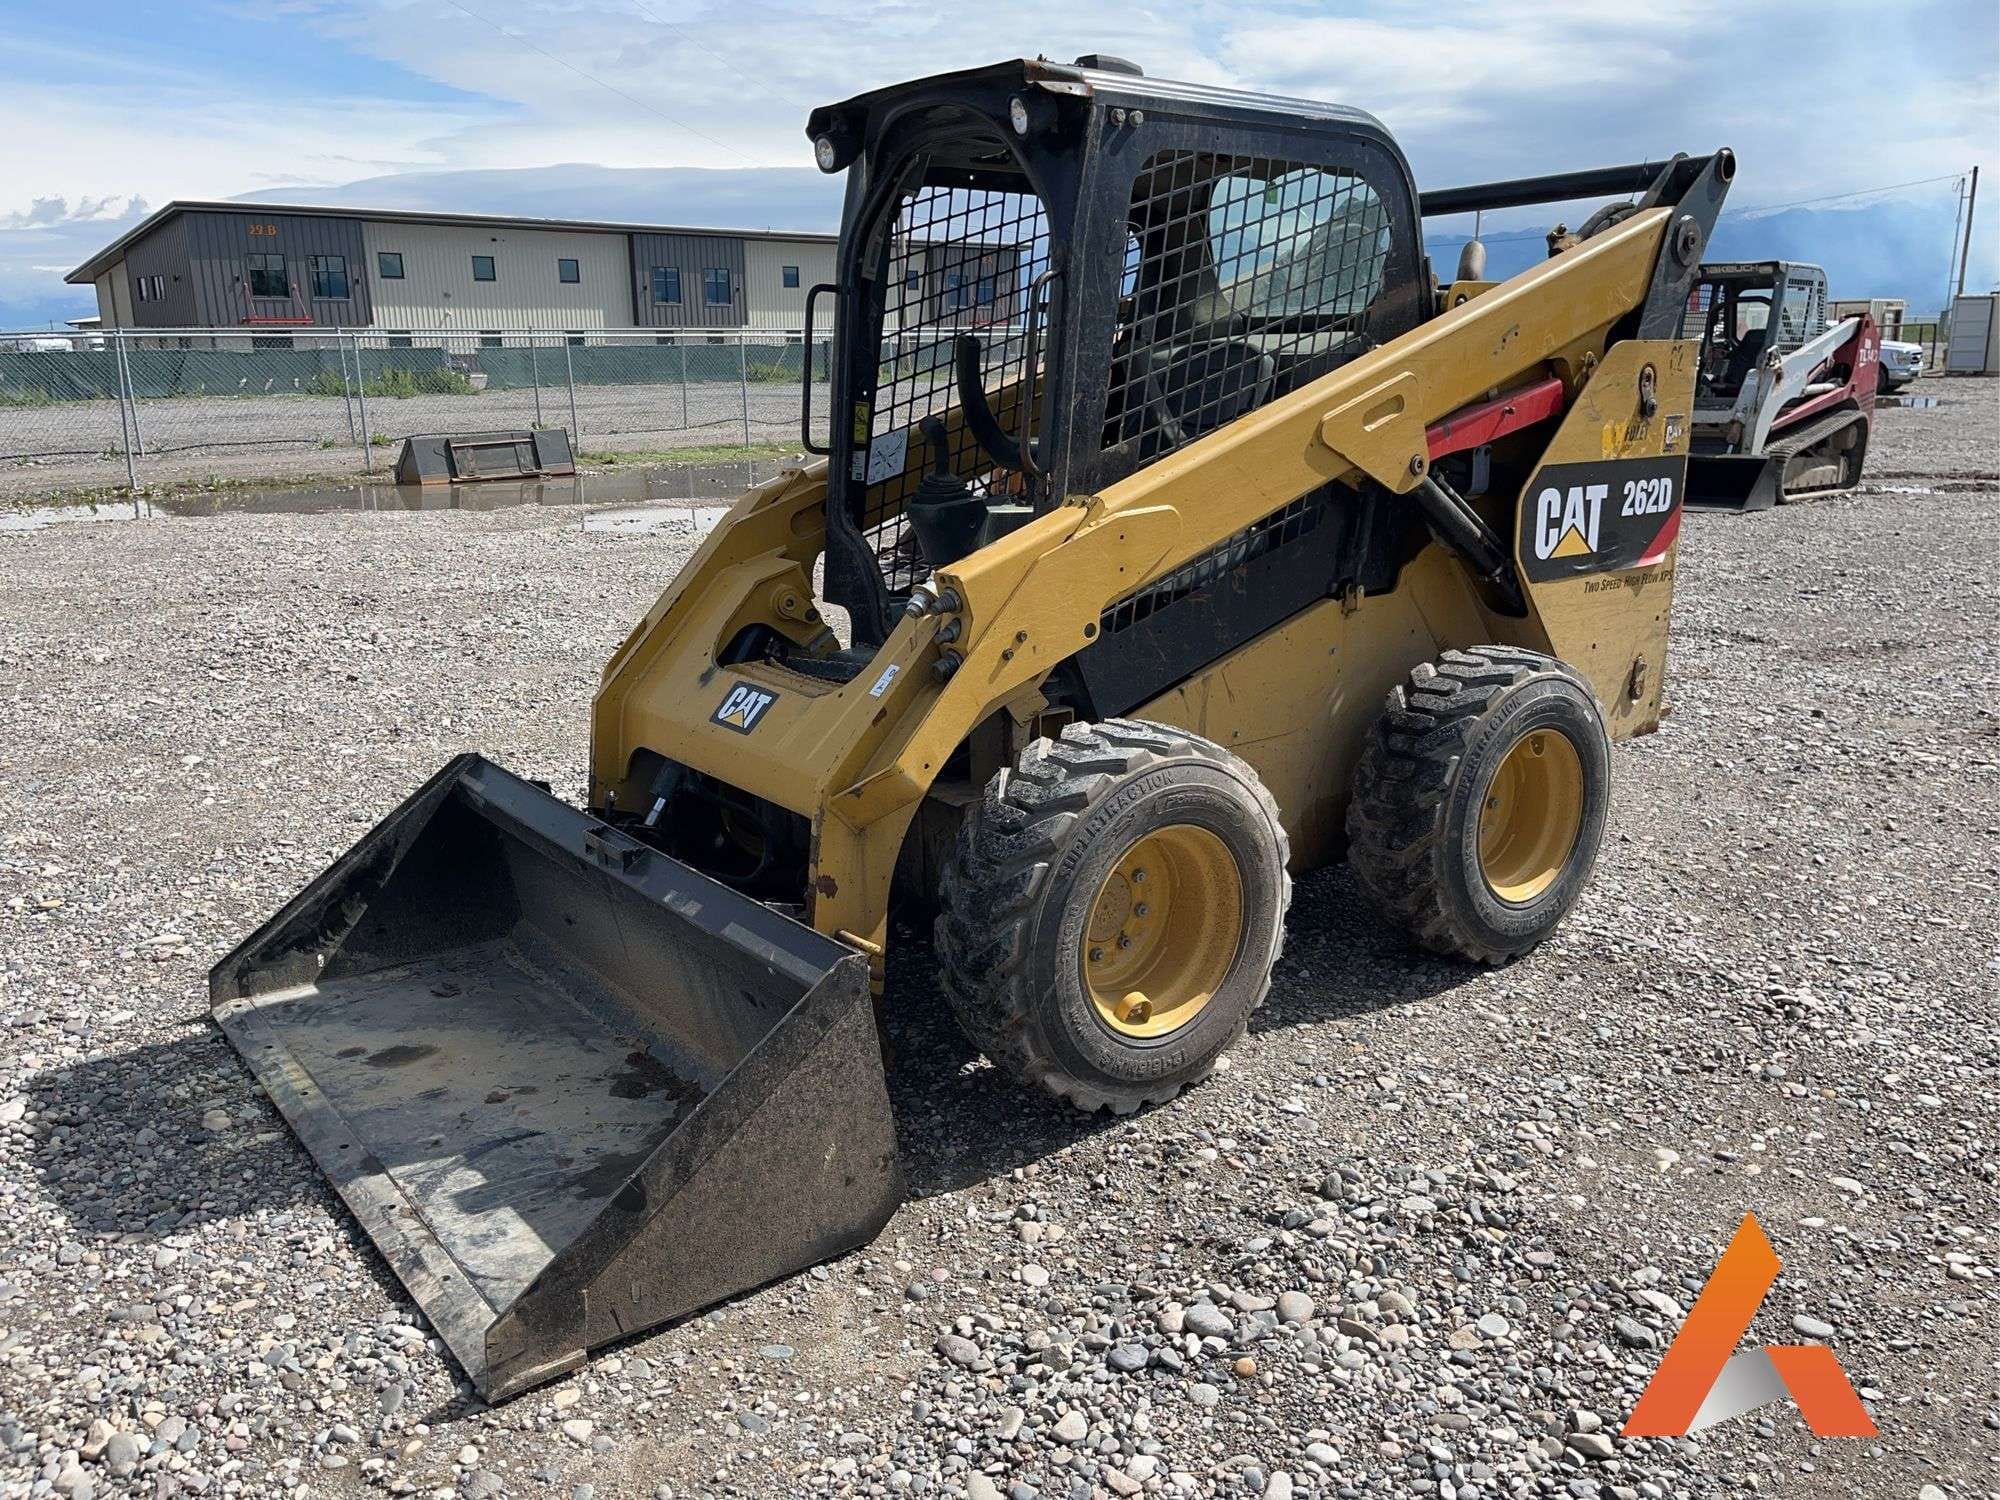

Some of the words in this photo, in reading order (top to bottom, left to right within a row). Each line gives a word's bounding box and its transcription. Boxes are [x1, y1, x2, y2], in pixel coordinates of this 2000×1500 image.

[1535, 484, 1608, 560] CAT
[1621, 477, 1672, 517] 262D
[1660, 569, 1673, 583] XPS
[718, 687, 772, 728] CAT
